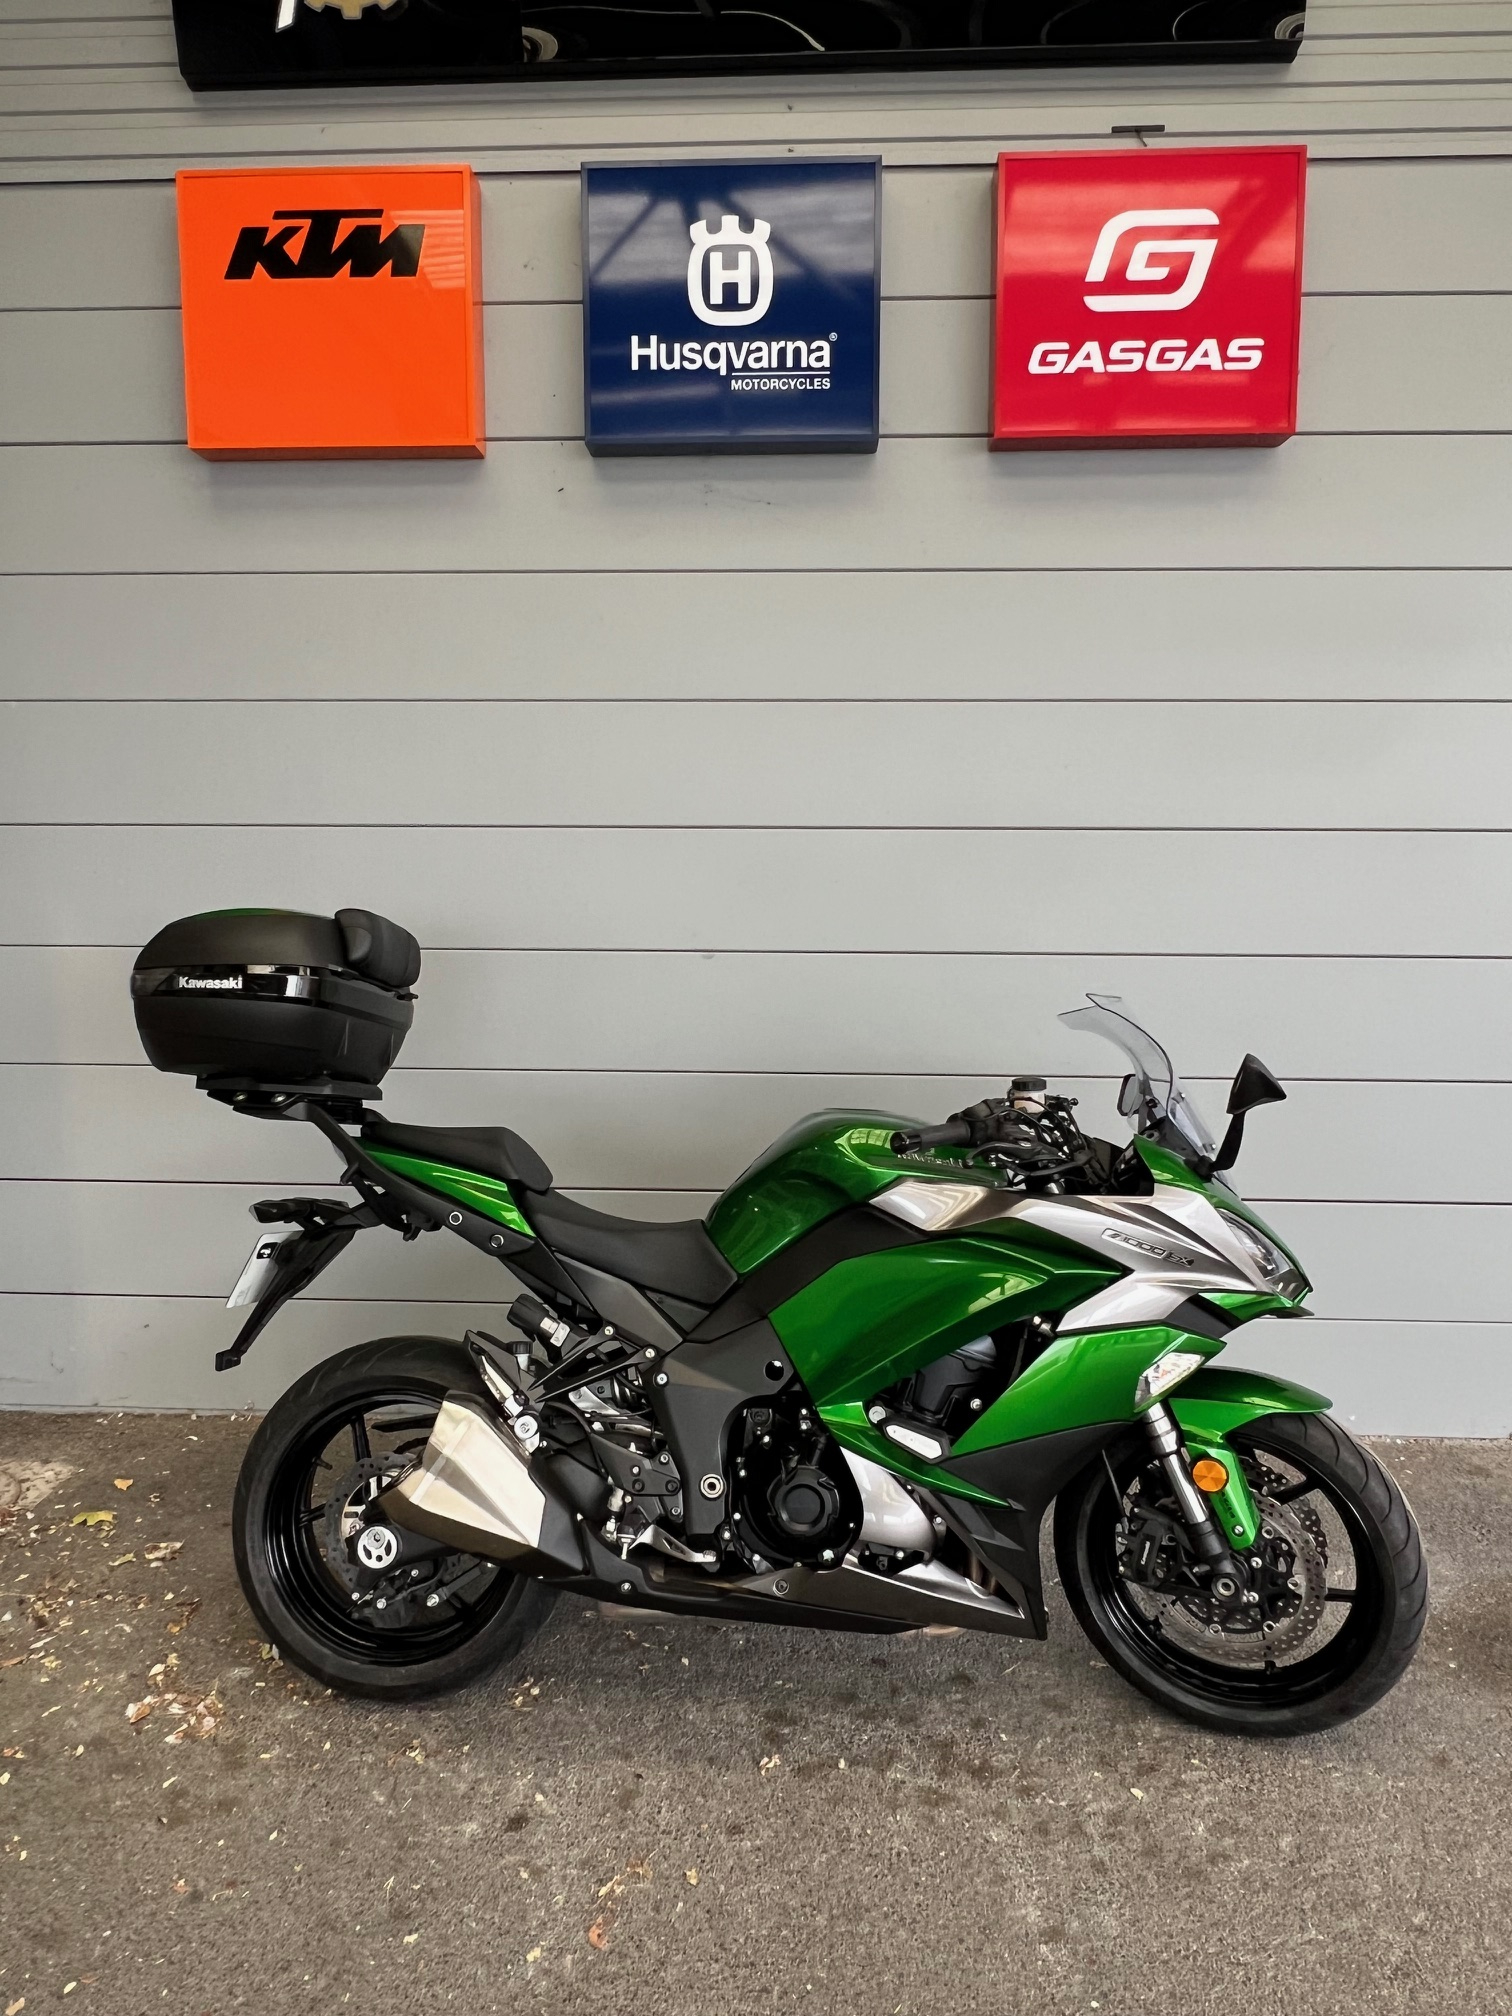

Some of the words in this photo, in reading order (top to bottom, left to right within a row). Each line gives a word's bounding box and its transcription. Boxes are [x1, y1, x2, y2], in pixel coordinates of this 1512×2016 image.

[224, 208, 426, 280] KTM
[1028, 337, 1265, 375] GASGAS
[730, 377, 832, 391] MOTORCYCLES
[178, 975, 243, 989] Kawasaki
